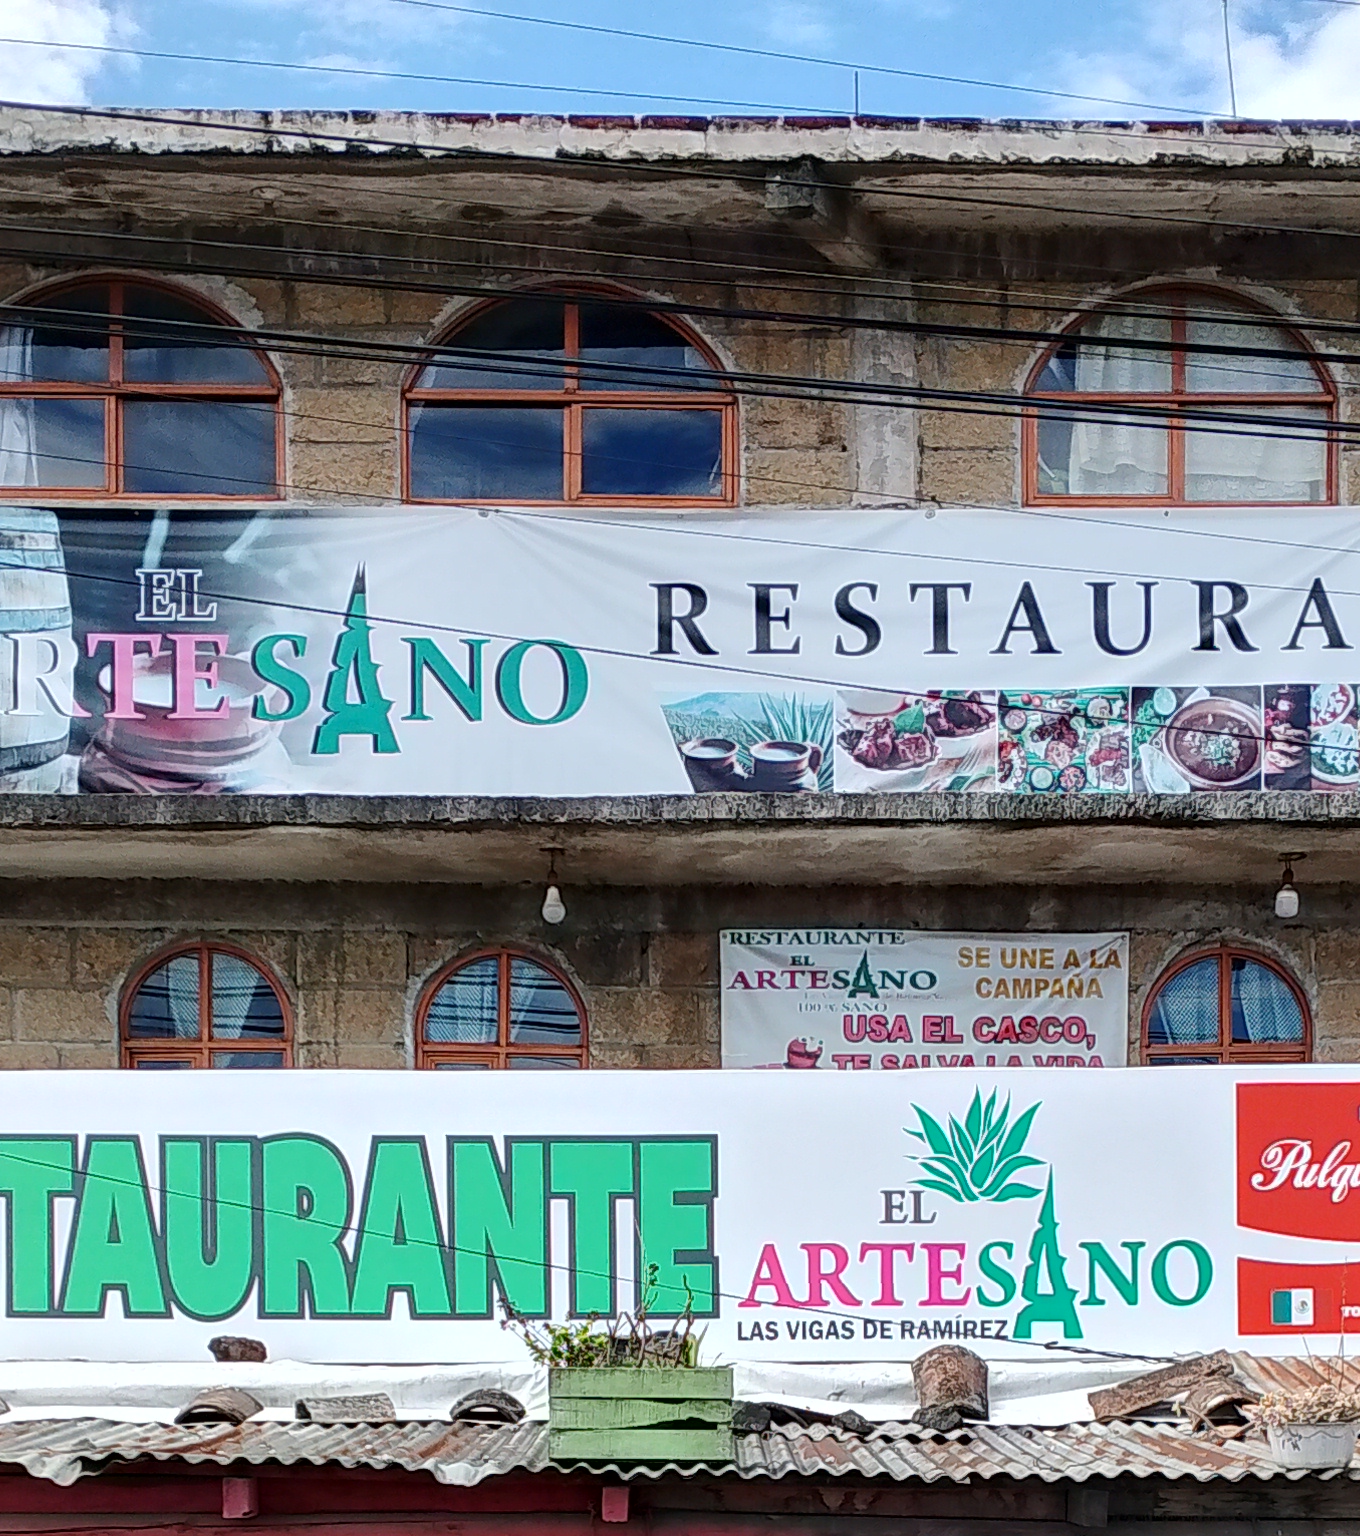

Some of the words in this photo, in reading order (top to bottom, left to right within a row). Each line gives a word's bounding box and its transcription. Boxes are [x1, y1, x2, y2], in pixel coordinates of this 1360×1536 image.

[135, 568, 218, 622] EL
[729, 931, 906, 945] RESTAURANTE
[789, 955, 815, 966] EL
[958, 946, 990, 968] SE
[1000, 947, 1054, 969] UNE
[1063, 948, 1081, 969] A
[1090, 948, 1122, 969] LA
[726, 947, 938, 998] ARTESANO
[975, 973, 1104, 998] CAMPAÑA
[842, 1003, 887, 1012] SANO
[843, 1015, 913, 1042] USA
[922, 1015, 964, 1042] EL
[972, 1015, 1096, 1050] CASCO,
[879, 1190, 937, 1224] EL
[737, 1164, 1213, 1339] ARTESANO
[737, 1321, 779, 1341] LAS
[786, 1321, 855, 1340] VIGAS
[863, 1321, 892, 1340] DE
[901, 1314, 1009, 1340] RAMÍREZ
